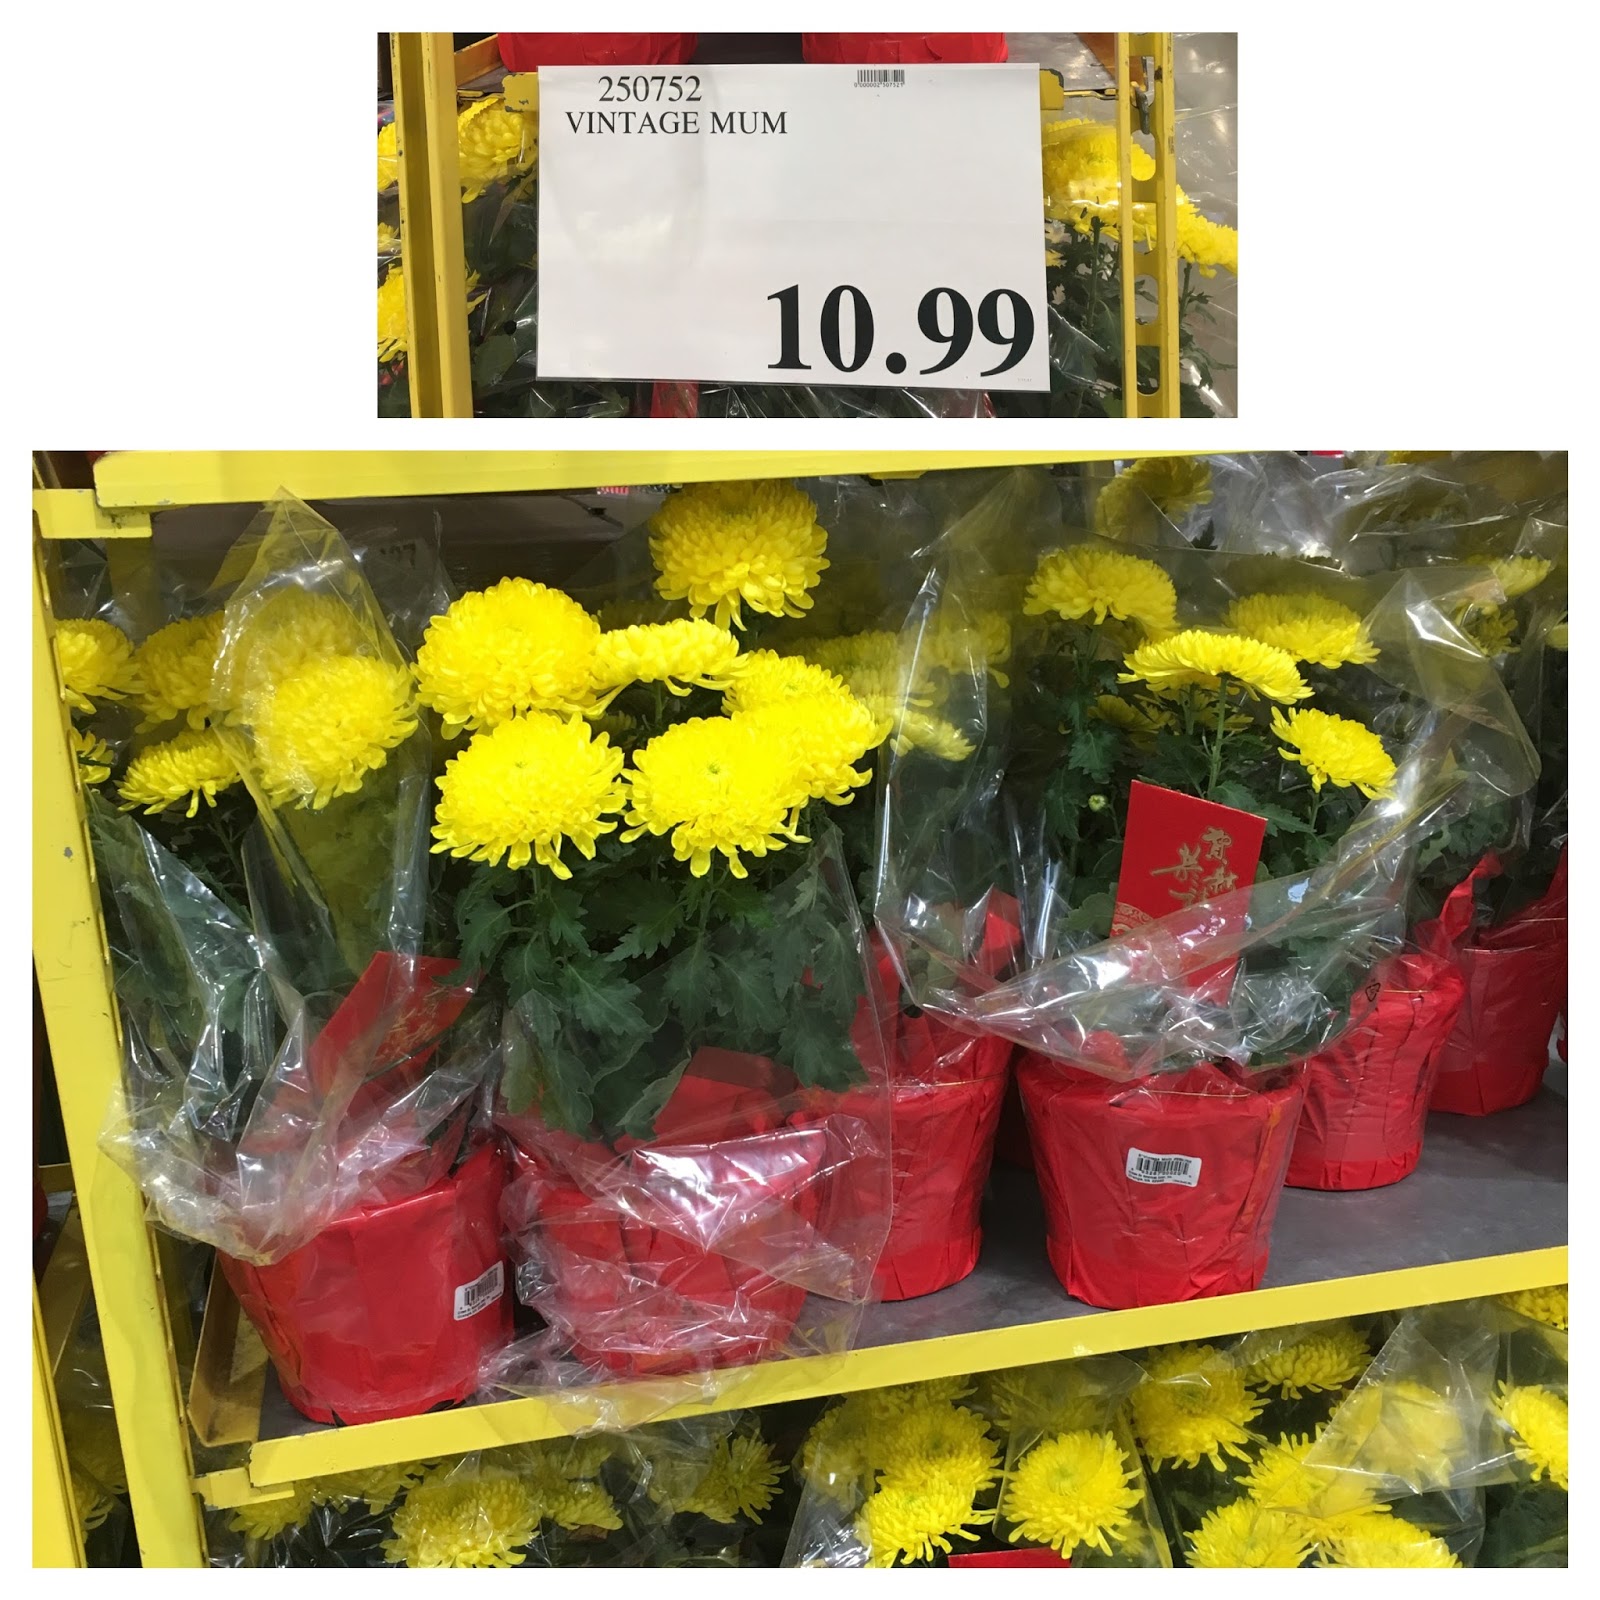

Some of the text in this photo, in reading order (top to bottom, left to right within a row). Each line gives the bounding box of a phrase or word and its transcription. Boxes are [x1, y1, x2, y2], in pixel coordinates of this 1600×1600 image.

[598, 75, 702, 102] 250752
[565, 111, 788, 135] VINTAGE MUM
[767, 284, 1035, 377] 10.99
